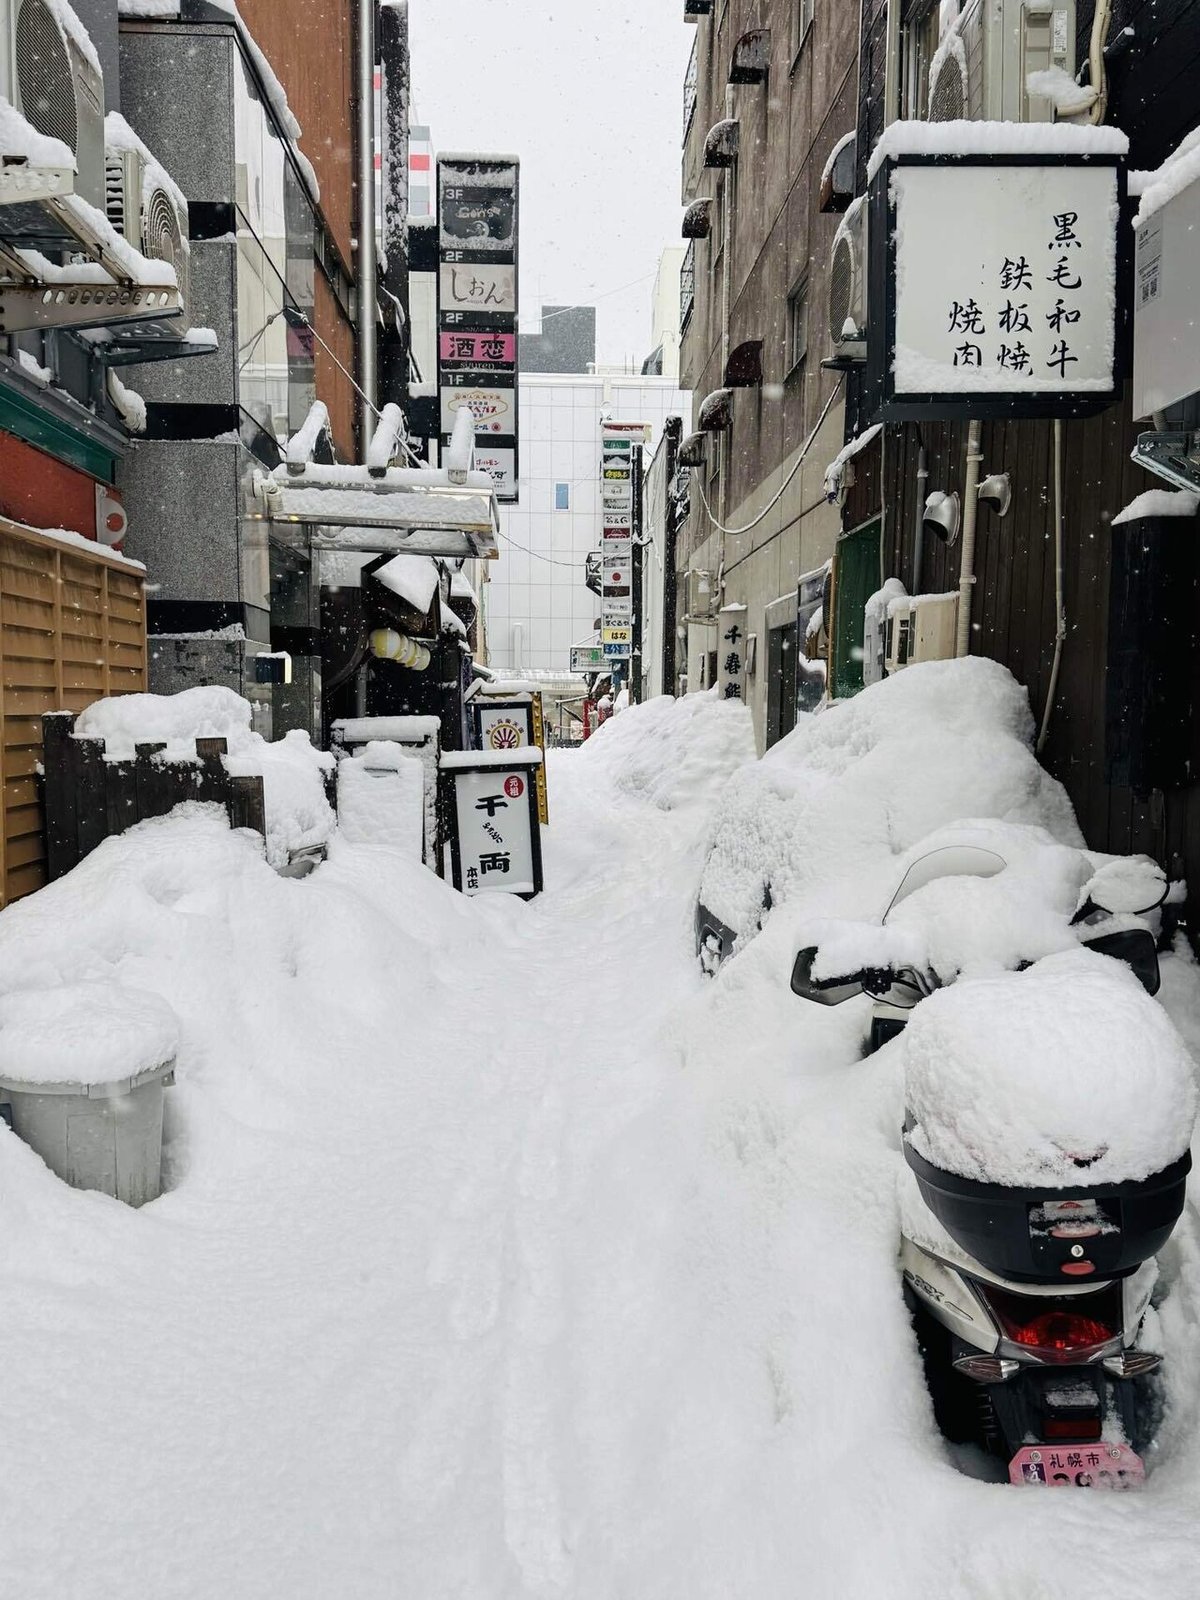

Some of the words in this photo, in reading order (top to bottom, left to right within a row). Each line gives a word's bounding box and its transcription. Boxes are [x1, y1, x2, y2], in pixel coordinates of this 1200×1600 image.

[445, 189, 464, 199] 3F
[445, 251, 464, 261] 2F
[450, 267, 504, 305] しおん
[1046, 211, 1082, 379] 黒毛和牛
[445, 312, 464, 323] 2F
[997, 256, 1034, 376] 鉄板焼
[947, 298, 985, 368] 焼肉
[448, 335, 505, 359] 酒恋
[447, 374, 464, 385] 1F
[611, 632, 627, 640] はな
[508, 777, 519, 797] 元祖
[466, 866, 479, 890] 本店
[1049, 1452, 1100, 1469] 札幌市
